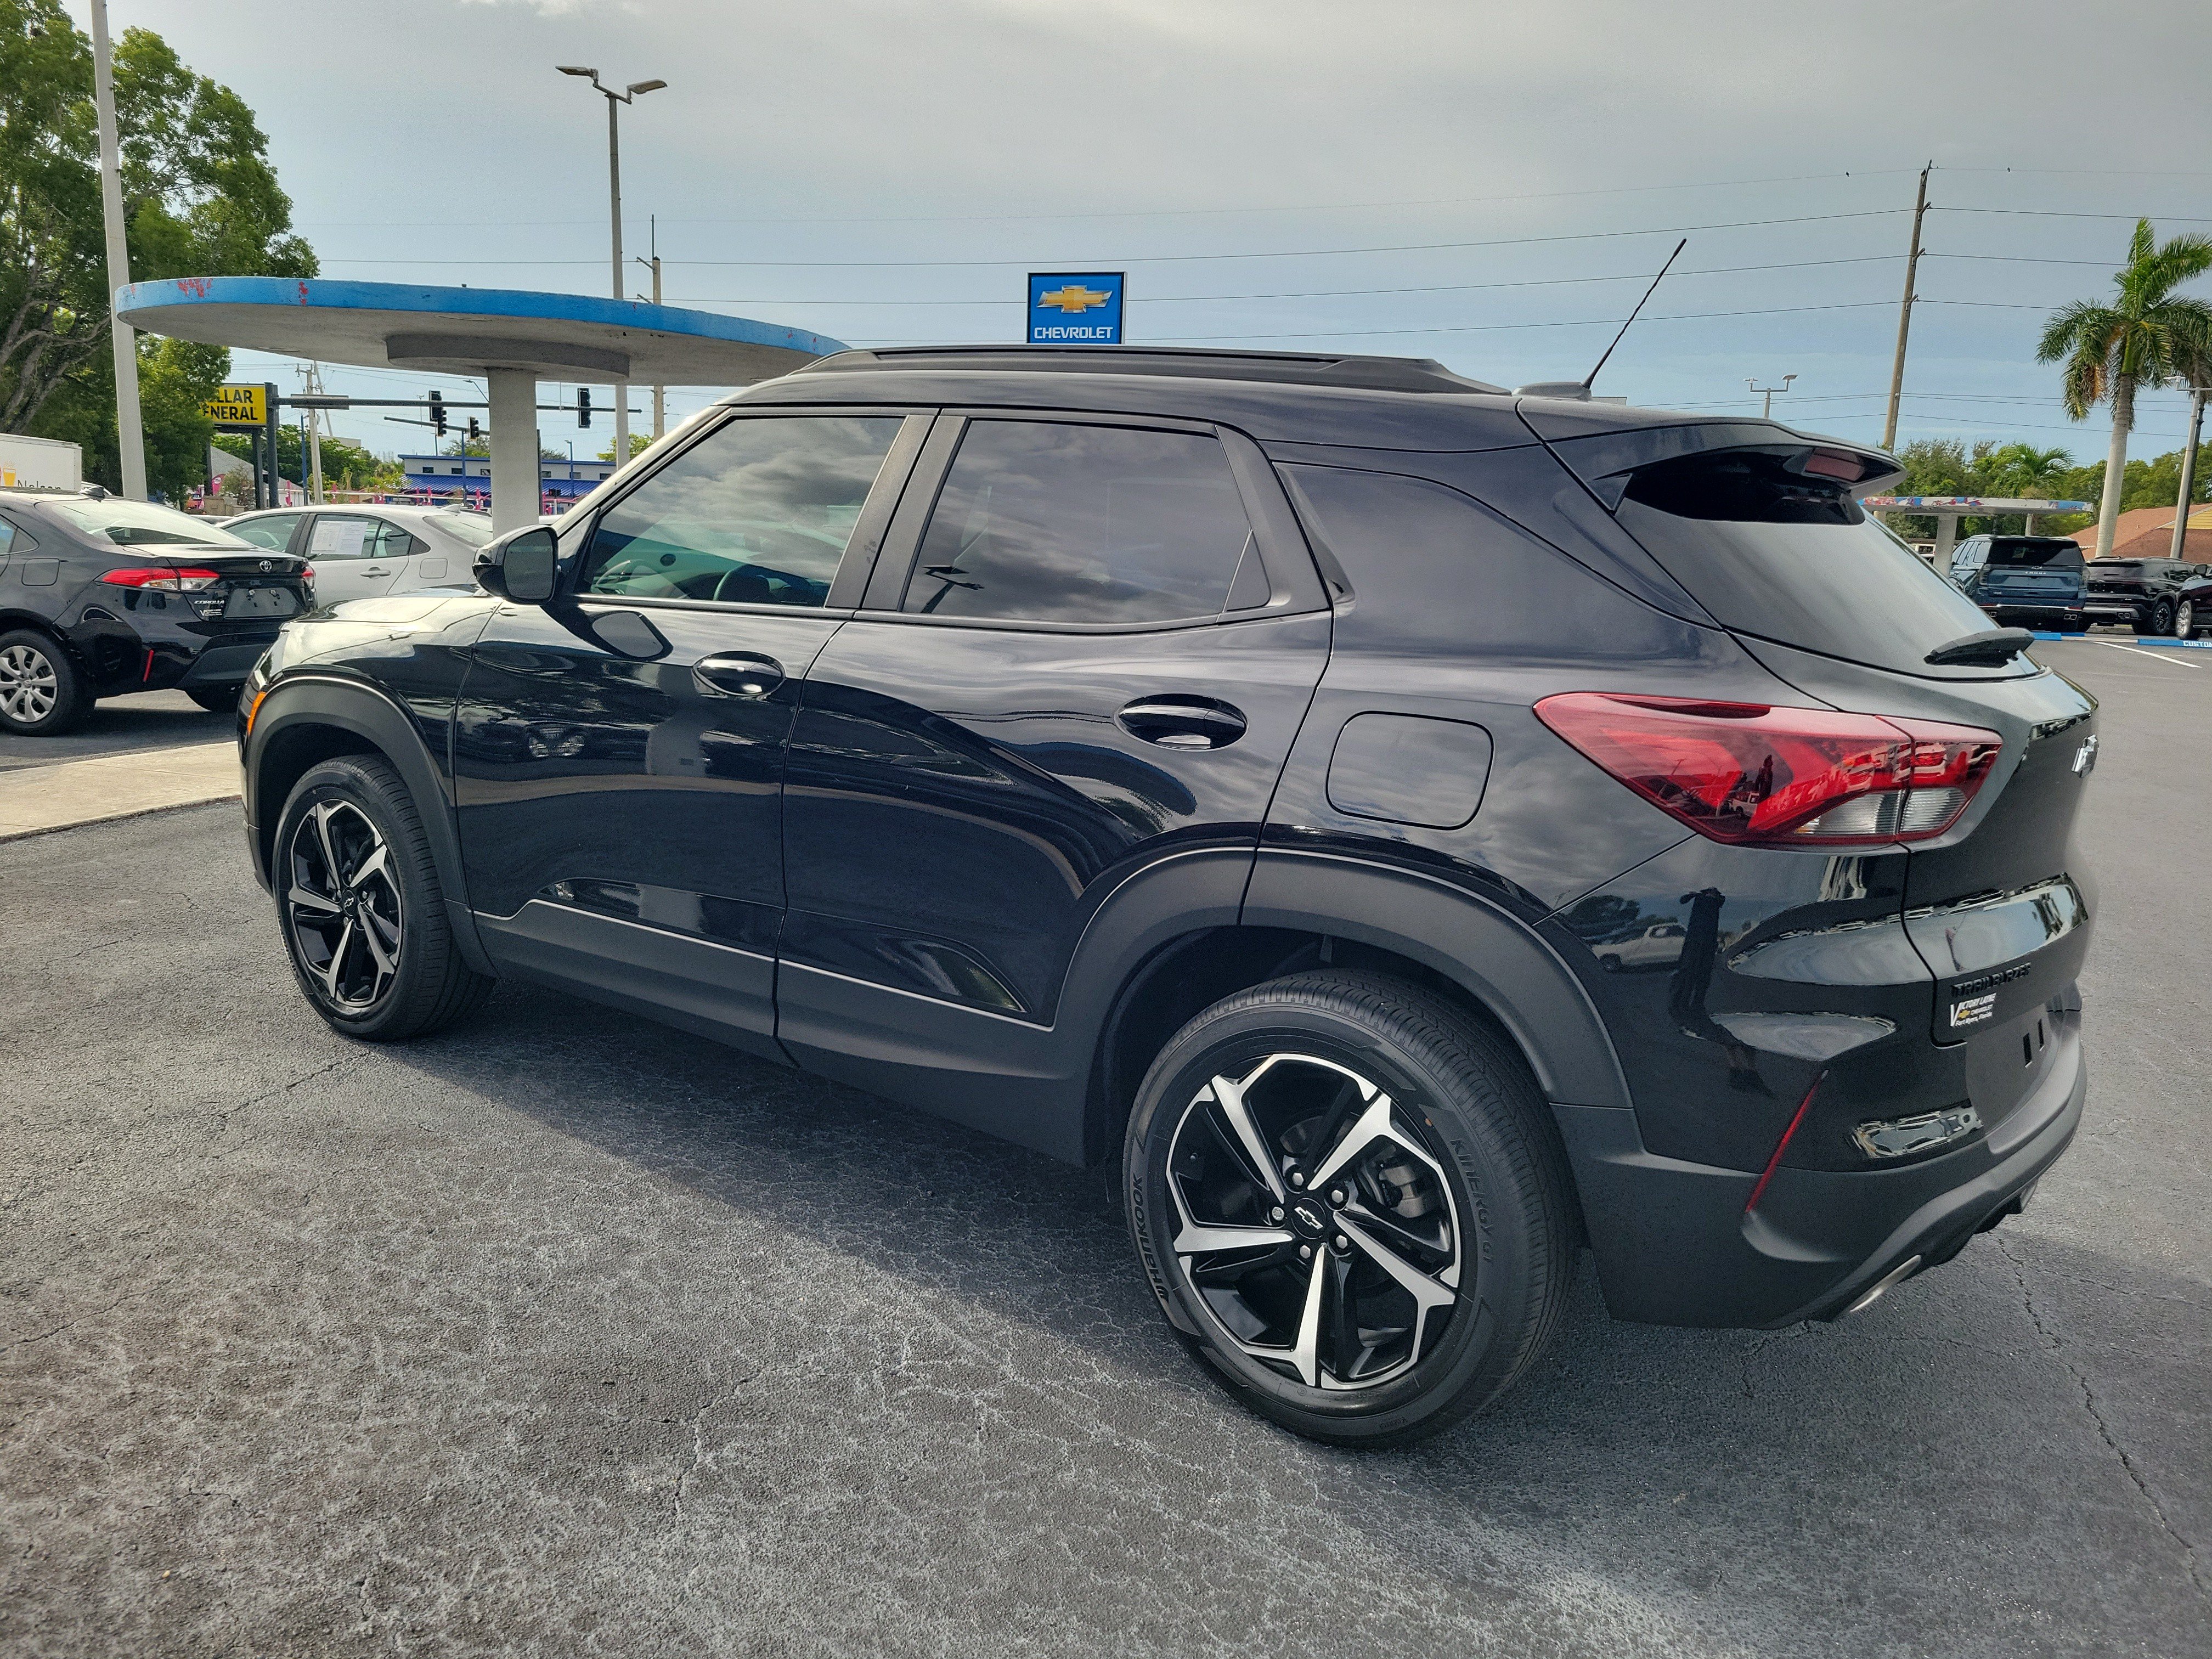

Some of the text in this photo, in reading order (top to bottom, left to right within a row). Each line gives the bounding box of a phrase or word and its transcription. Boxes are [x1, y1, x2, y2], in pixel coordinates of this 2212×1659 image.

[1034, 326, 1113, 339] CHEVROLET
[210, 390, 253, 404] LLAR
[202, 405, 258, 420] ENERAL
